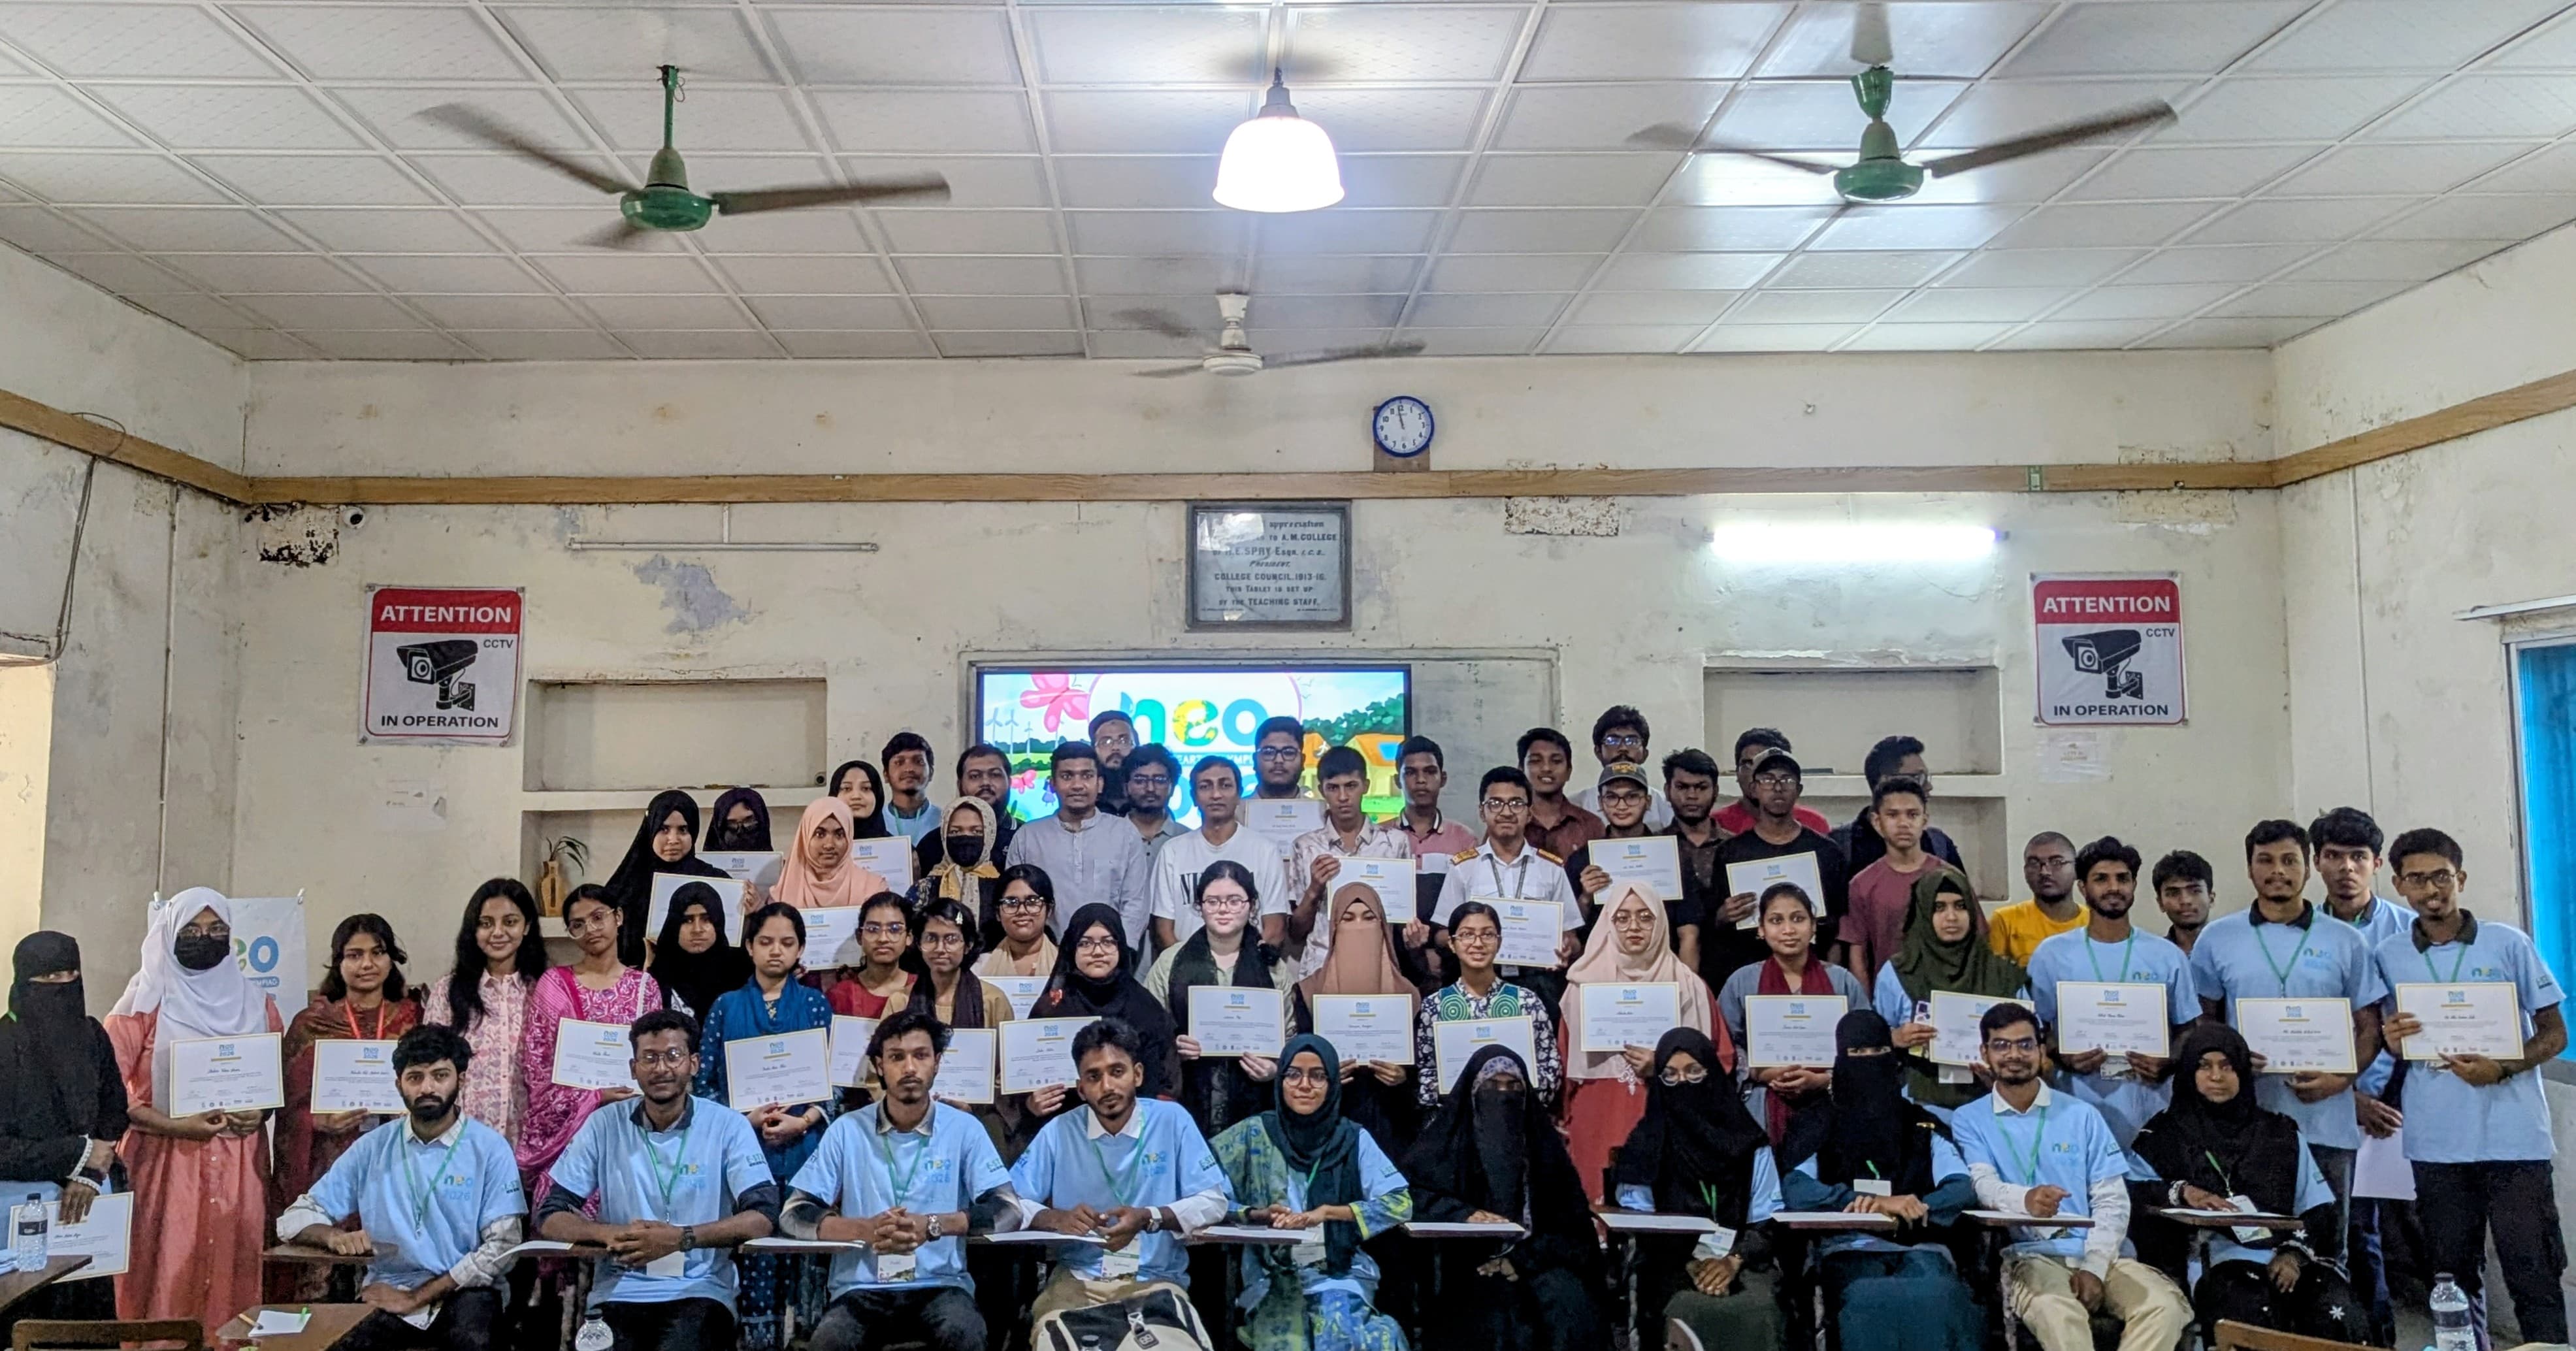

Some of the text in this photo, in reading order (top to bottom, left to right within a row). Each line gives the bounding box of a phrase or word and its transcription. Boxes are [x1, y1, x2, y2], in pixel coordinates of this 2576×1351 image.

[1248, 598, 1290, 606] TEACHING
[2043, 595, 2170, 613] ATTENTION
[381, 605, 512, 623] ATTENTION
[2145, 628, 2175, 638] CCTV
[483, 639, 514, 649] CCTV
[2053, 704, 2168, 716] IN OPERATION
[381, 715, 498, 728] IN OPERATION
[1120, 691, 1269, 747] neo
[444, 1175, 474, 1188] neo
